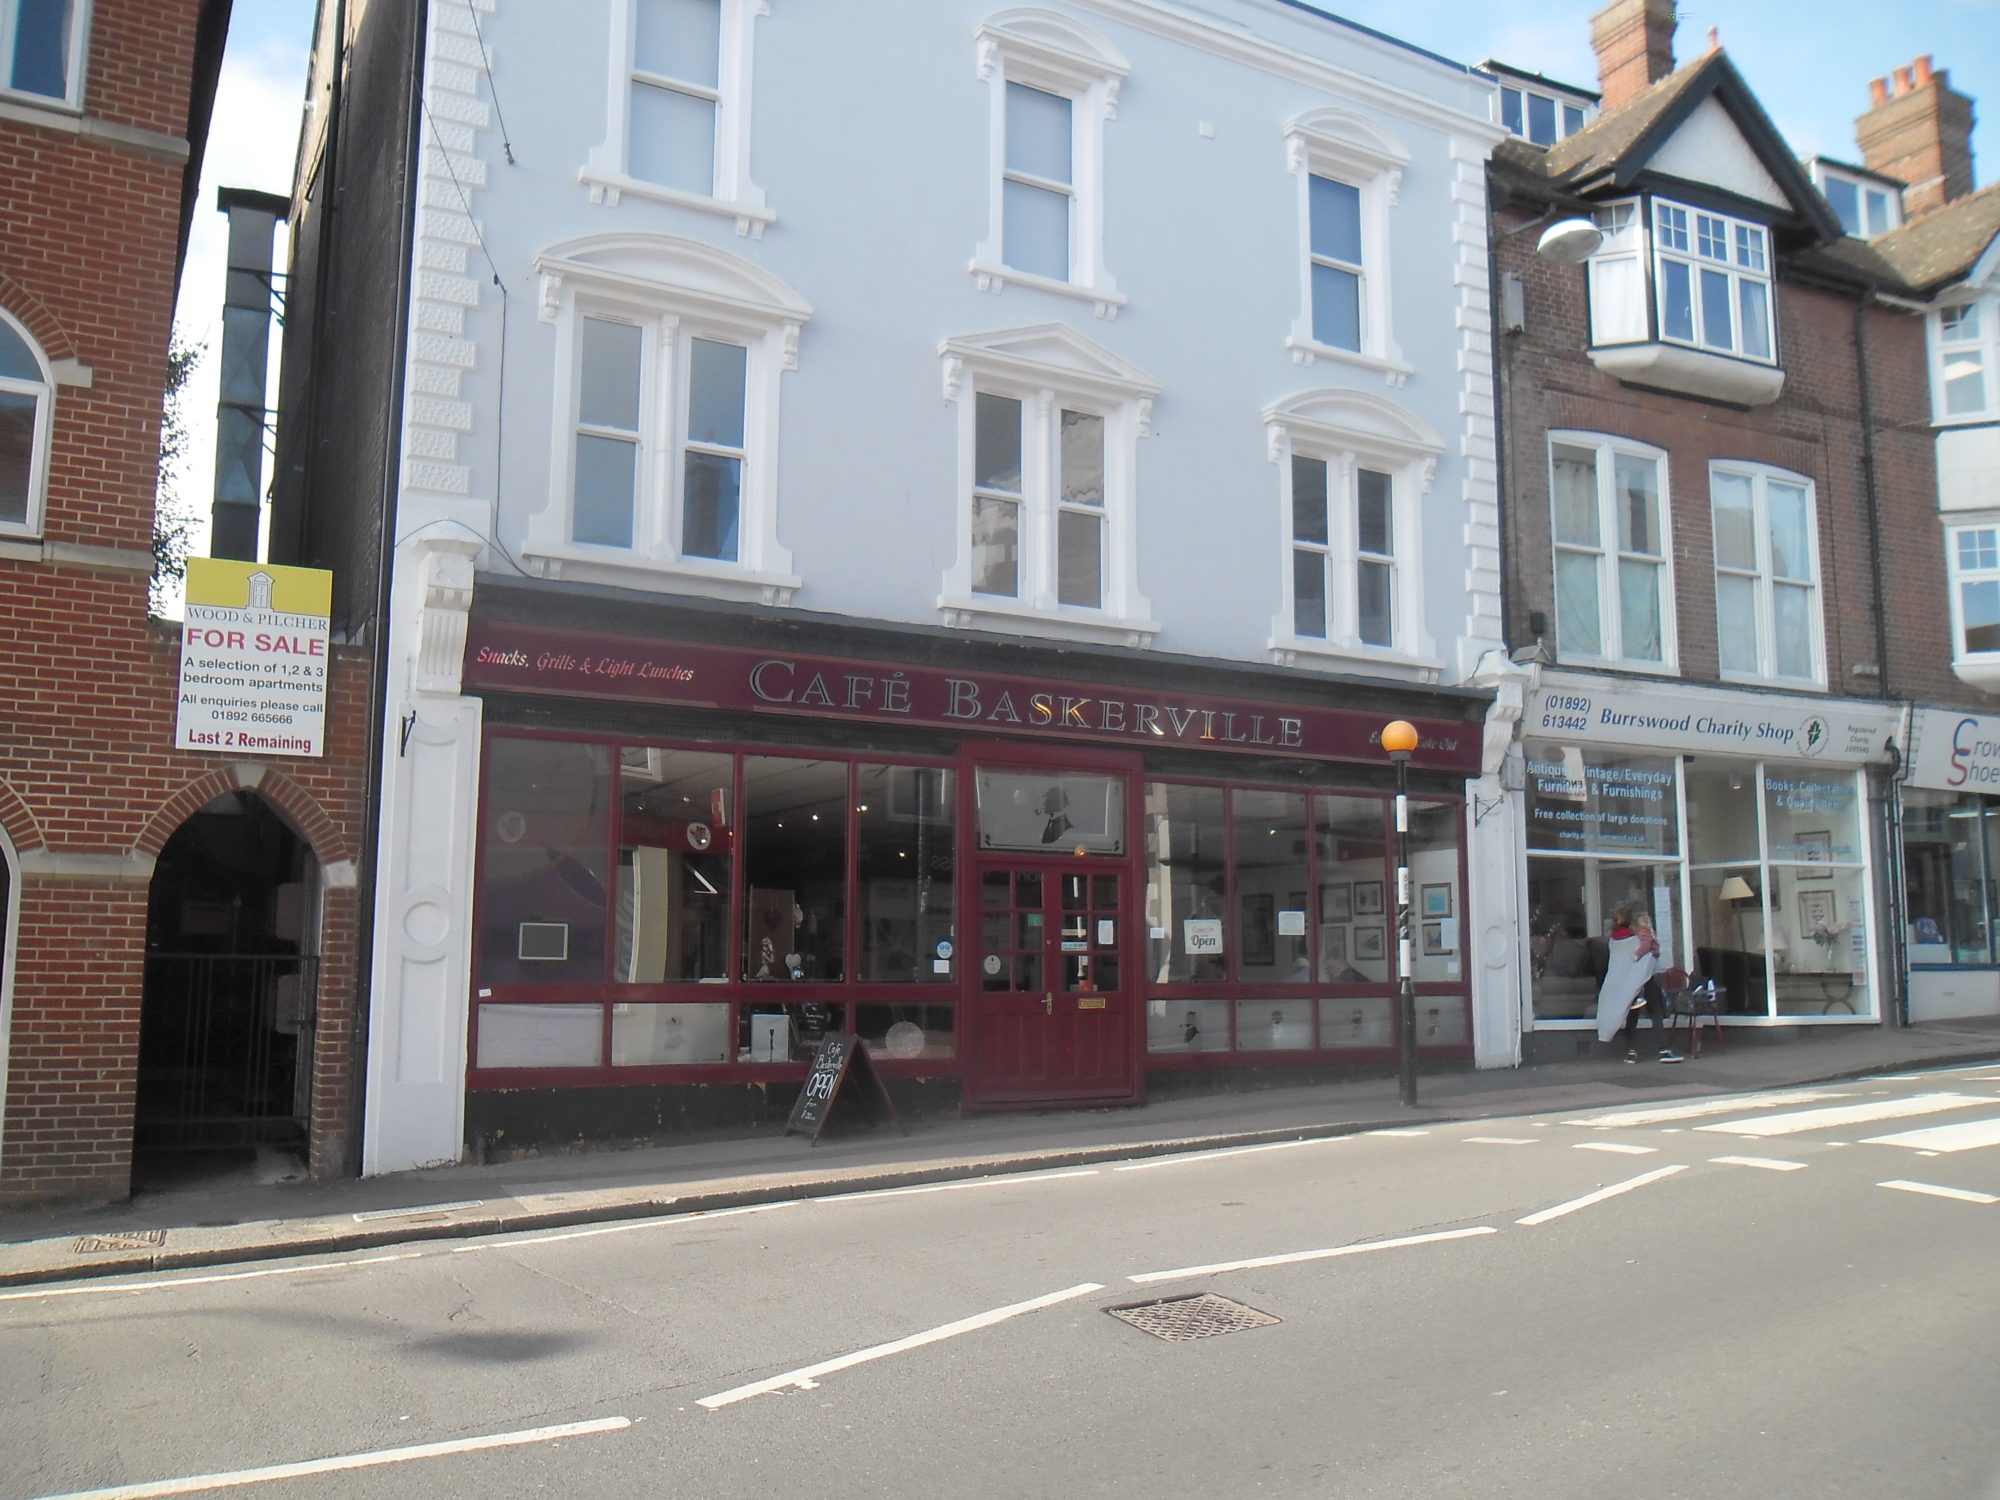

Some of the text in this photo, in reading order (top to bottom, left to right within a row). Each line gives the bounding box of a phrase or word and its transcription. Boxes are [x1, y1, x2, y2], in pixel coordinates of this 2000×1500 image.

[188, 608, 327, 630] WOOD & PILCHER
[187, 628, 325, 656] FOR SALE
[185, 657, 323, 677] A selection of 1,2 & 3
[537, 652, 576, 671] Grills
[579, 658, 591, 674] &
[594, 658, 635, 678] Light
[637, 661, 694, 681] Lunches
[183, 672, 323, 692] bedroom apartments
[181, 694, 323, 714] All enquiries please call
[750, 659, 1303, 747] CAFÉ BASKERVILLE
[1545, 695, 1591, 714] (01892)
[212, 710, 293, 725] 01892 665666
[1542, 714, 1587, 731] 613442
[1600, 708, 1691, 731] Burrswood
[1696, 717, 1752, 741] Charity
[1756, 722, 1794, 744] Shop
[189, 729, 311, 753] Last 2 Remaining
[1527, 760, 1581, 779] Antique
[1591, 783, 1600, 796] &
[1602, 783, 1664, 801] Furnishings
[1534, 808, 1668, 826] Free collection of large donations
[1190, 934, 1216, 950] Open
[806, 1073, 838, 1099] OPEN
